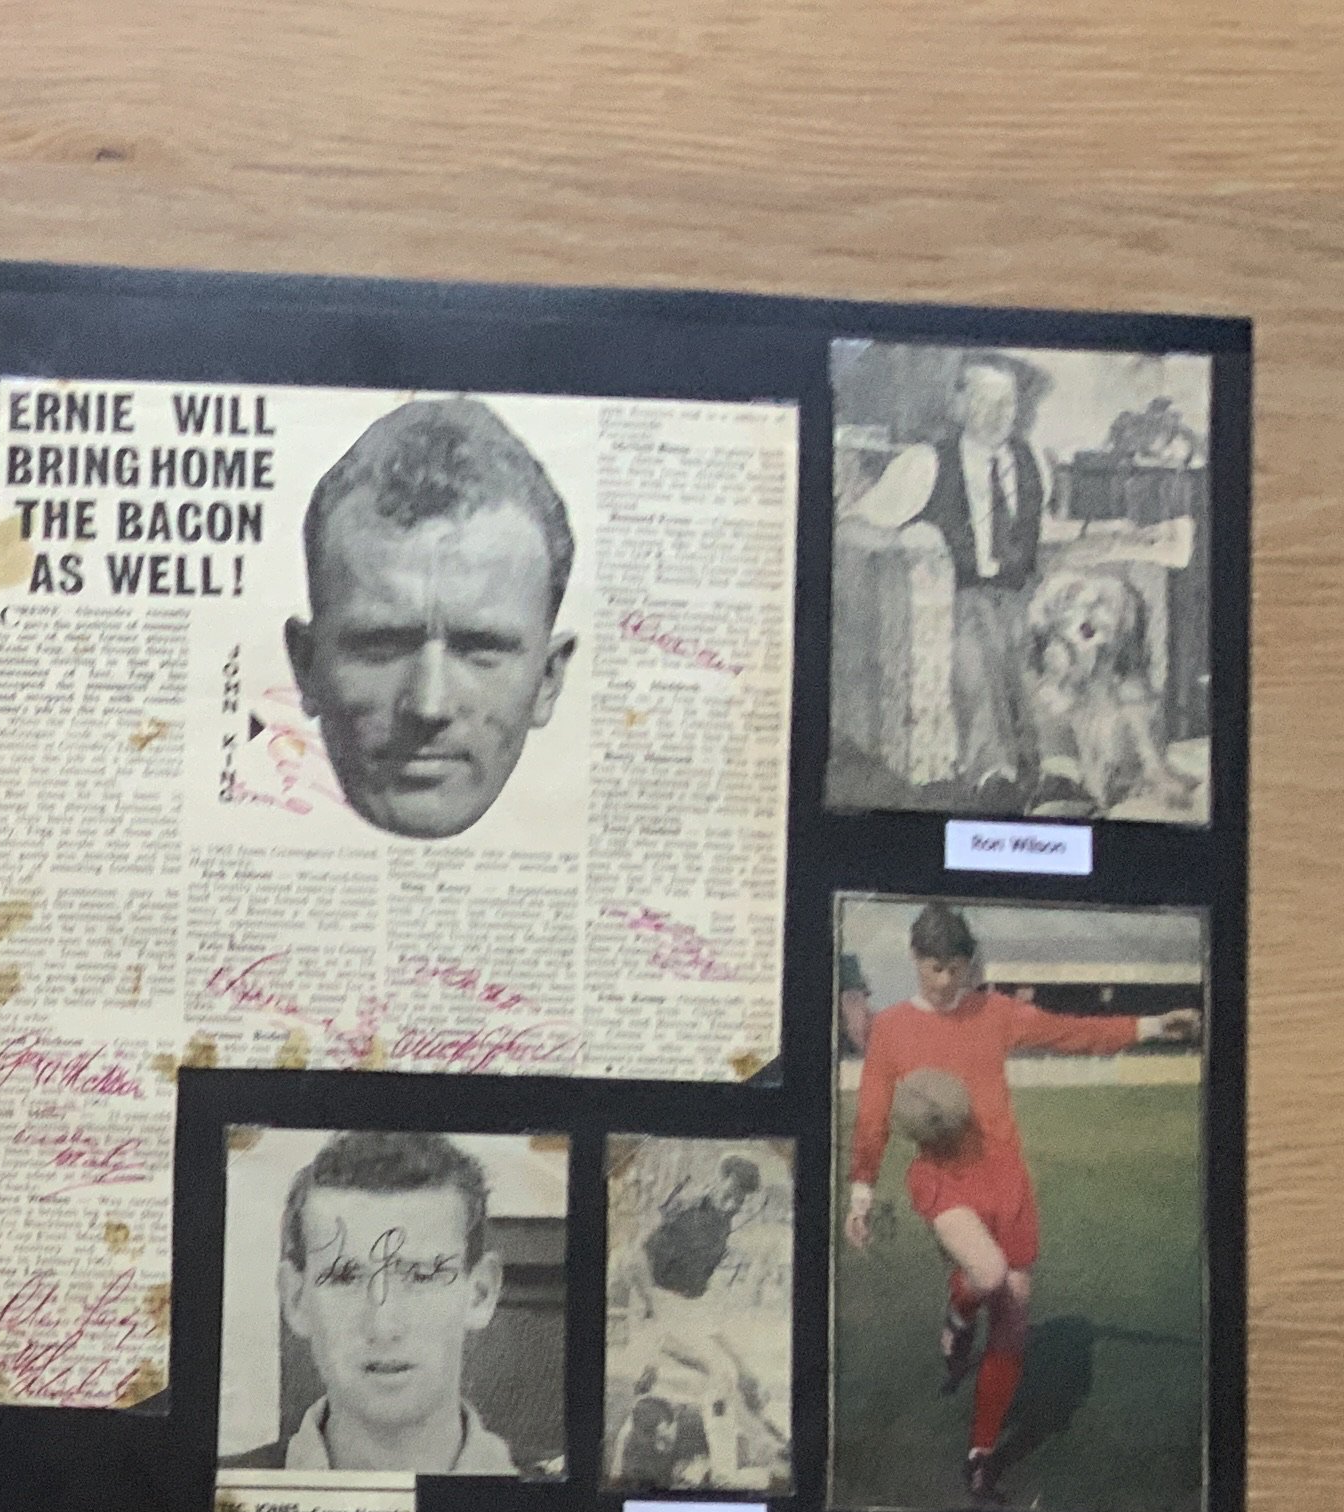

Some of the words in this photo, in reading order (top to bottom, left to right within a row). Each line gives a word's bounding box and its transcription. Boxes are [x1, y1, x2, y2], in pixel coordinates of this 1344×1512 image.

[9, 391, 134, 433] ERNIE
[172, 393, 276, 436] WILL
[6, 446, 138, 487] BRING
[150, 447, 275, 489] HOME
[15, 498, 97, 541] THE
[117, 500, 263, 543] BACON
[29, 552, 84, 594] AS
[106, 553, 244, 597] WELL!
[221, 644, 240, 713] JOHN
[219, 733, 237, 803] KING
[970, 835, 1006, 852] Ron
